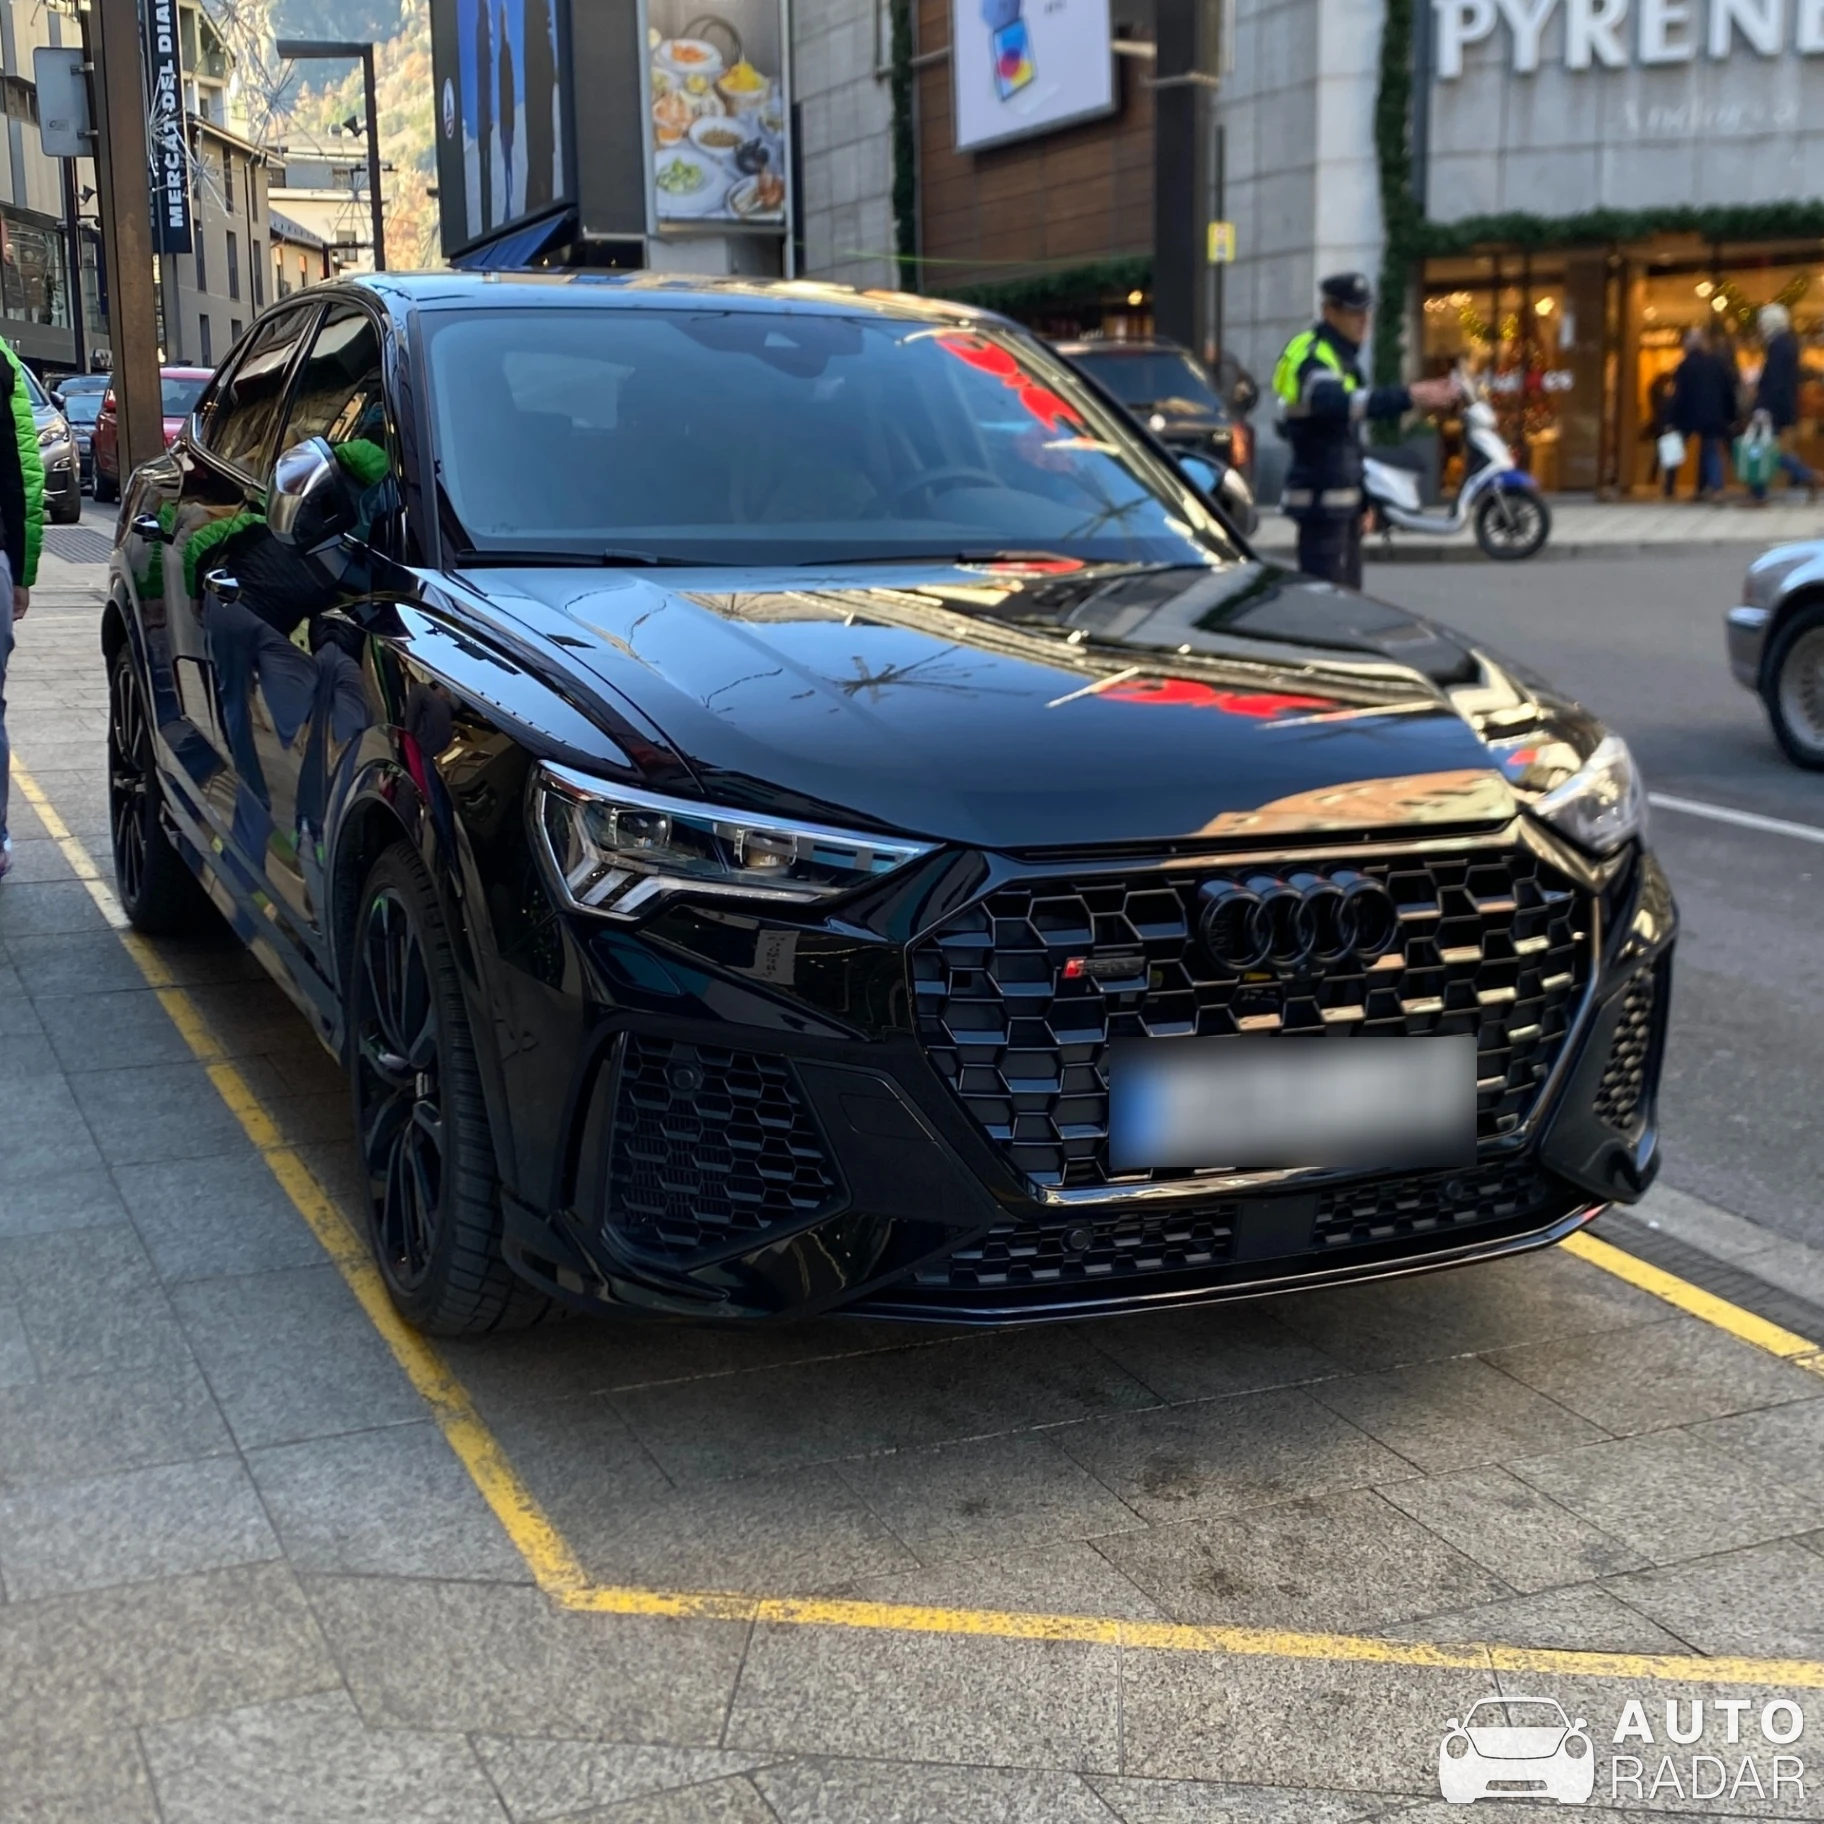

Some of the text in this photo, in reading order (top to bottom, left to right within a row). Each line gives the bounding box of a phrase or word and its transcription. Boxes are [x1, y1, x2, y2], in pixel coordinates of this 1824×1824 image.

[155, 0, 184, 228] MERCAT DEL DIA
